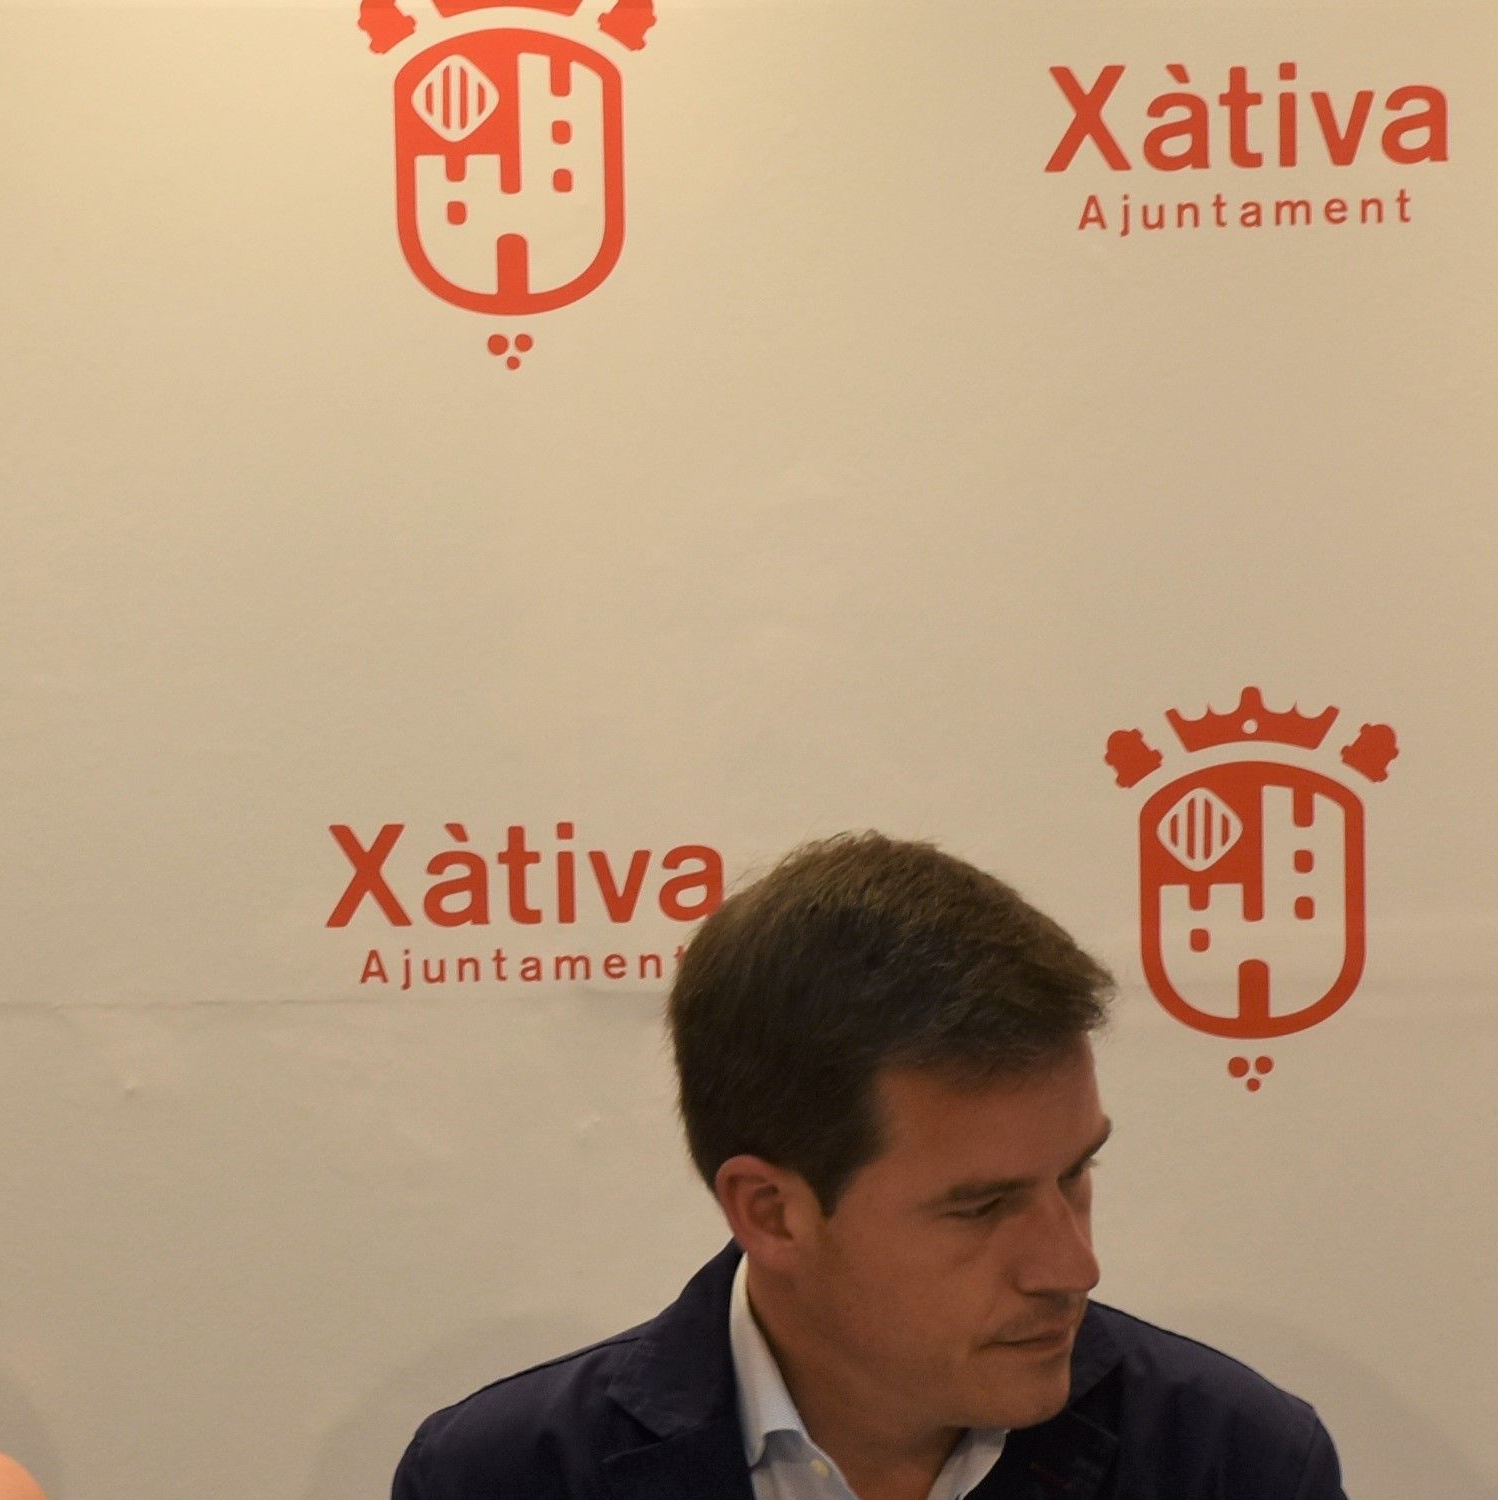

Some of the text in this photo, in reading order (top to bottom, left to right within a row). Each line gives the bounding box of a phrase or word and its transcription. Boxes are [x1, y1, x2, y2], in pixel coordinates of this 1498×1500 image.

[1044, 60, 1452, 175] Xàtiva
[1078, 190, 1414, 239] Ajuntament
[325, 821, 727, 929] Xàtiva
